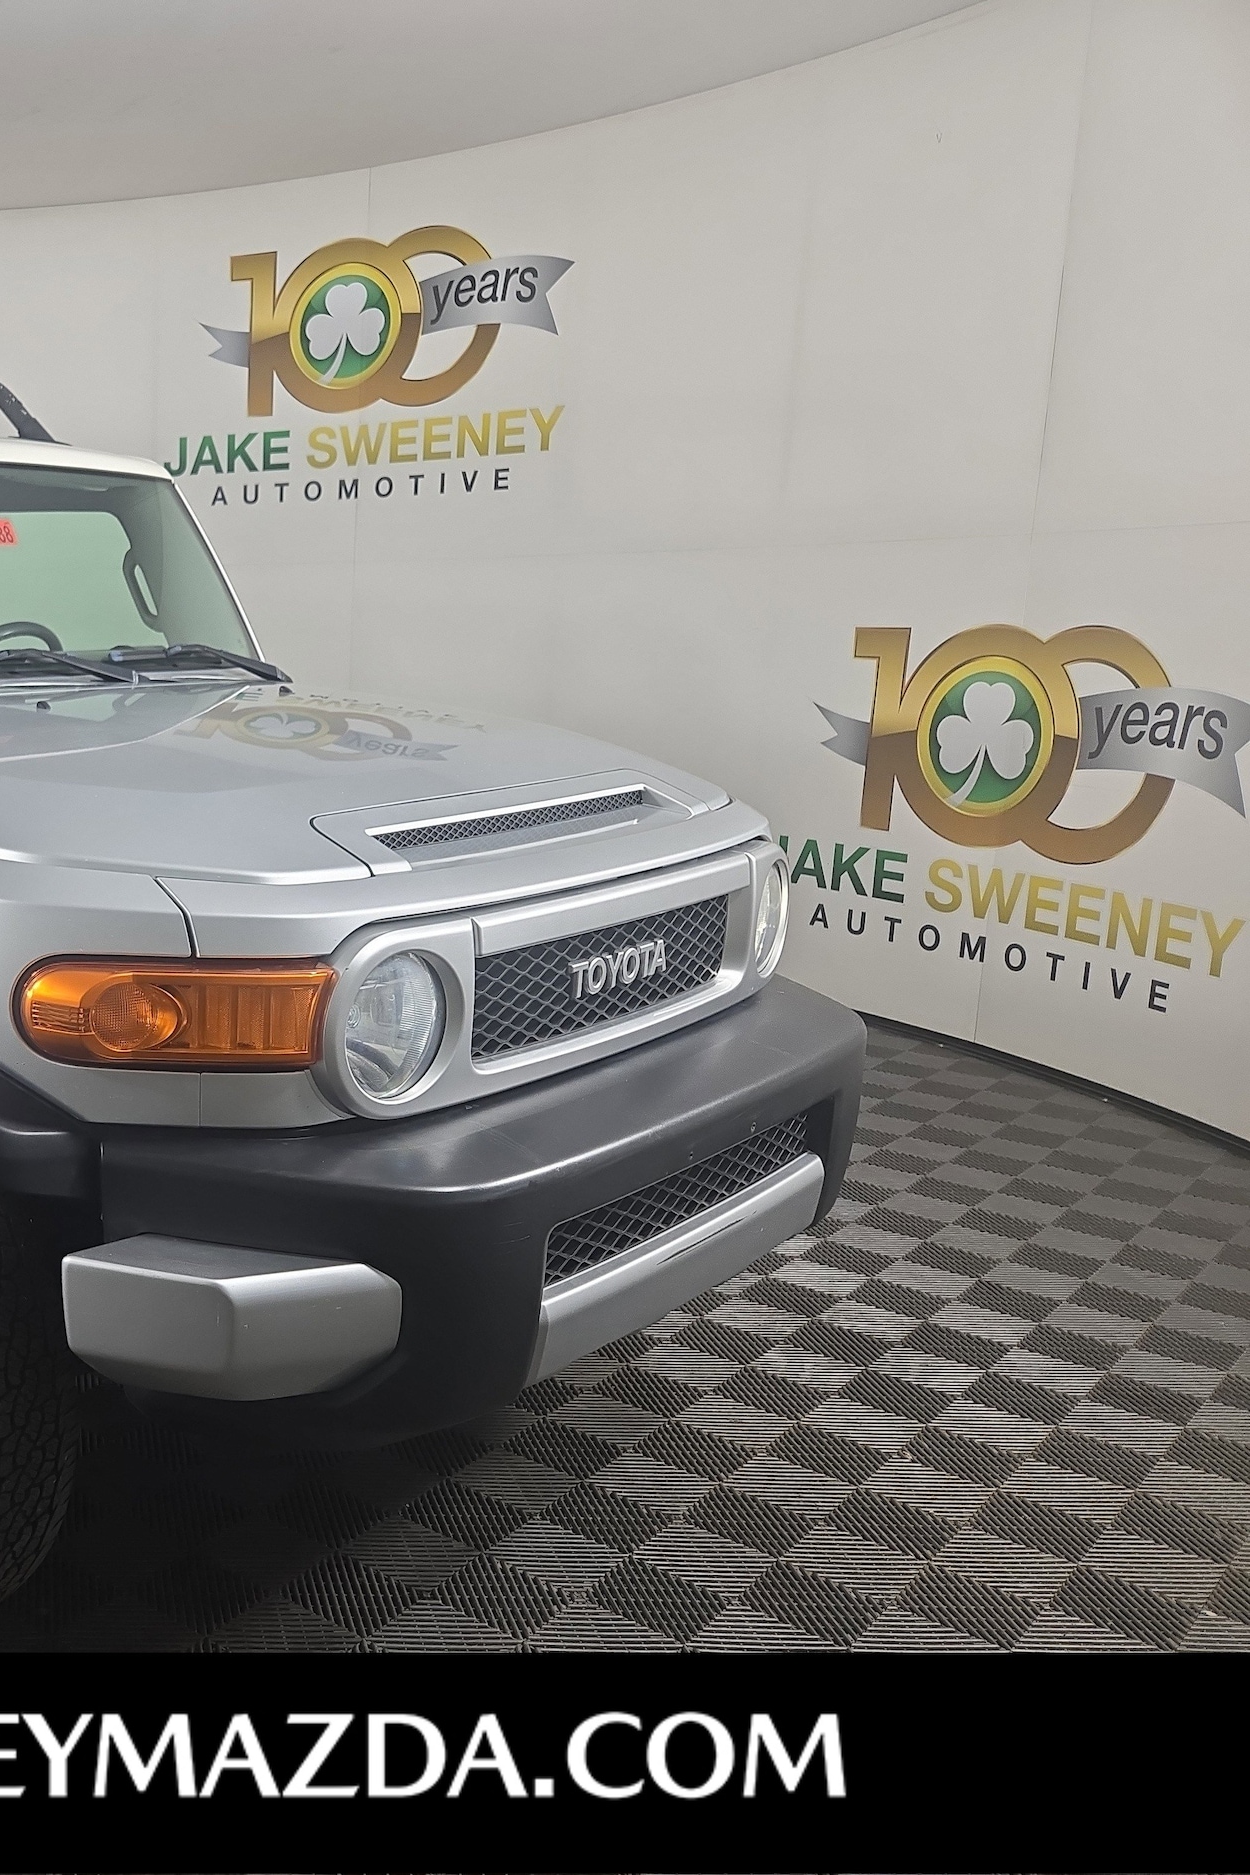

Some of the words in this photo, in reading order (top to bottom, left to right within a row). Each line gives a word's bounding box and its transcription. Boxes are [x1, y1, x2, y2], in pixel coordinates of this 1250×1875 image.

[430, 263, 540, 326] years
[163, 430, 291, 477] JAKE
[306, 405, 567, 471] SWEENEY
[210, 467, 511, 507] AUTOMOTIVE
[1087, 701, 1229, 761] years
[923, 858, 1247, 979] SWEENEY
[568, 938, 668, 999] TOYOTA
[808, 903, 1171, 1014] AUTOMOTIVE
